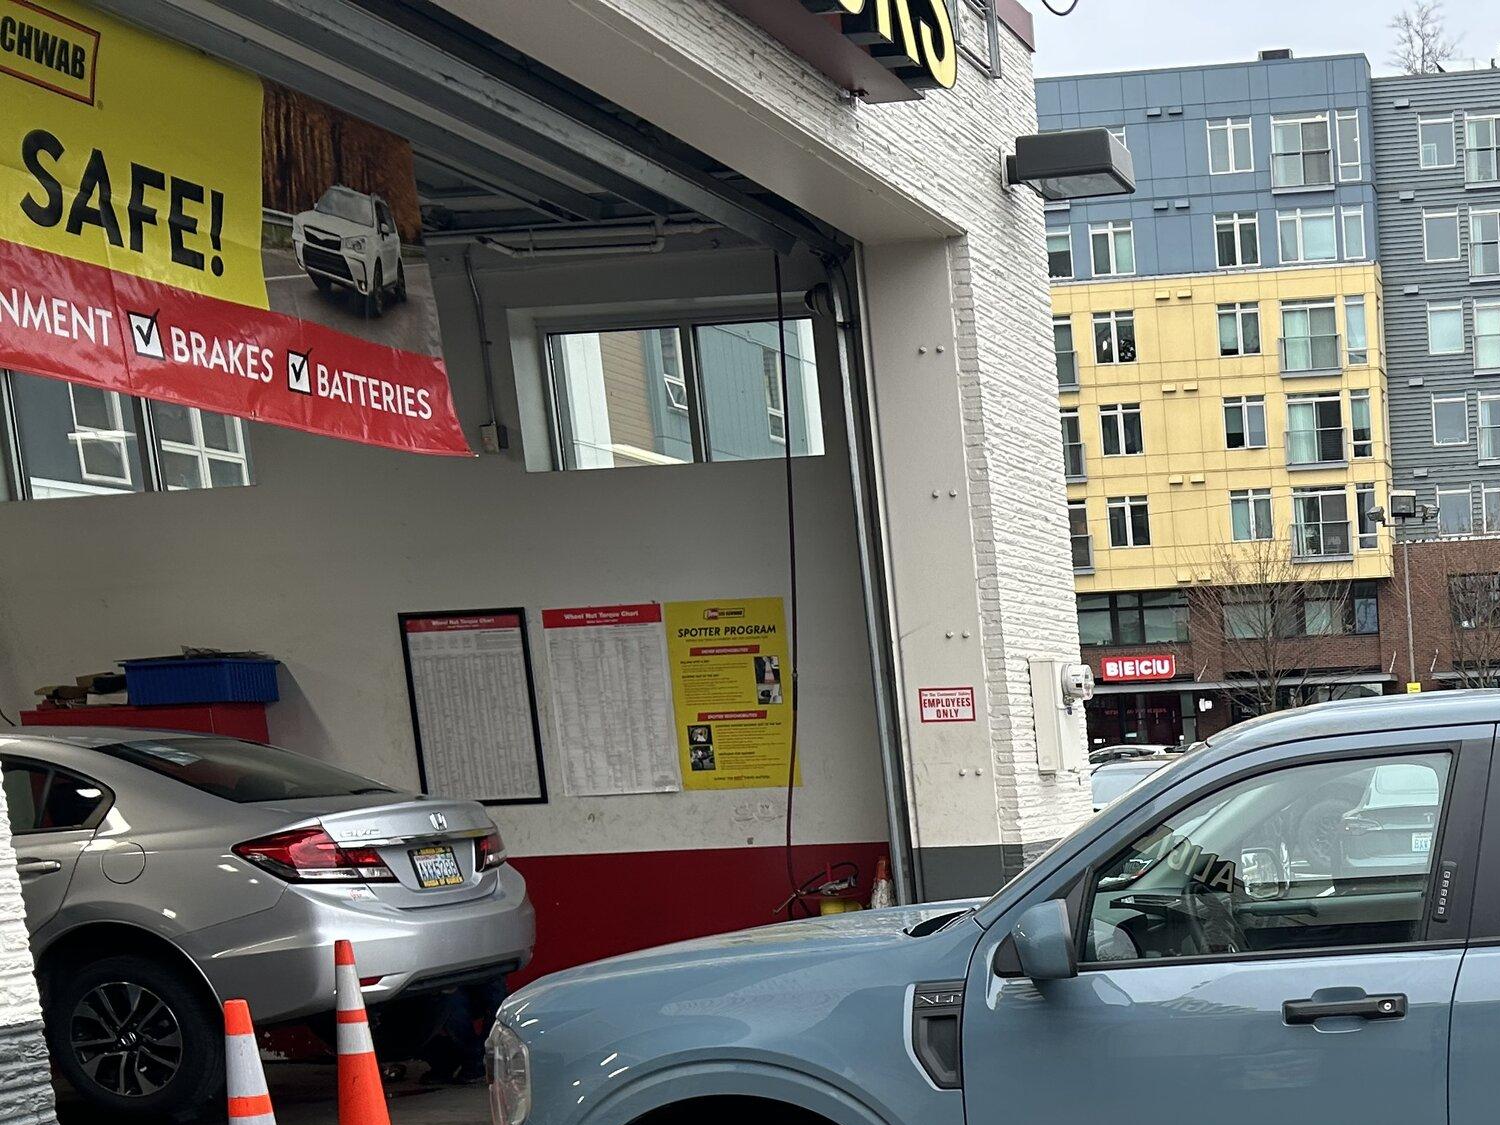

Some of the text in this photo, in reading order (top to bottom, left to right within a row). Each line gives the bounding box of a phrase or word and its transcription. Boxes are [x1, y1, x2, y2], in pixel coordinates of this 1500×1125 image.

[19, 129, 225, 277] SAFE!
[171, 327, 274, 383] BRAKES
[316, 364, 433, 421] BATTERIES
[678, 624, 777, 638] SPOTTER PROGRAM
[922, 697, 971, 708] EMPLOYEES
[936, 709, 960, 718] ONLY
